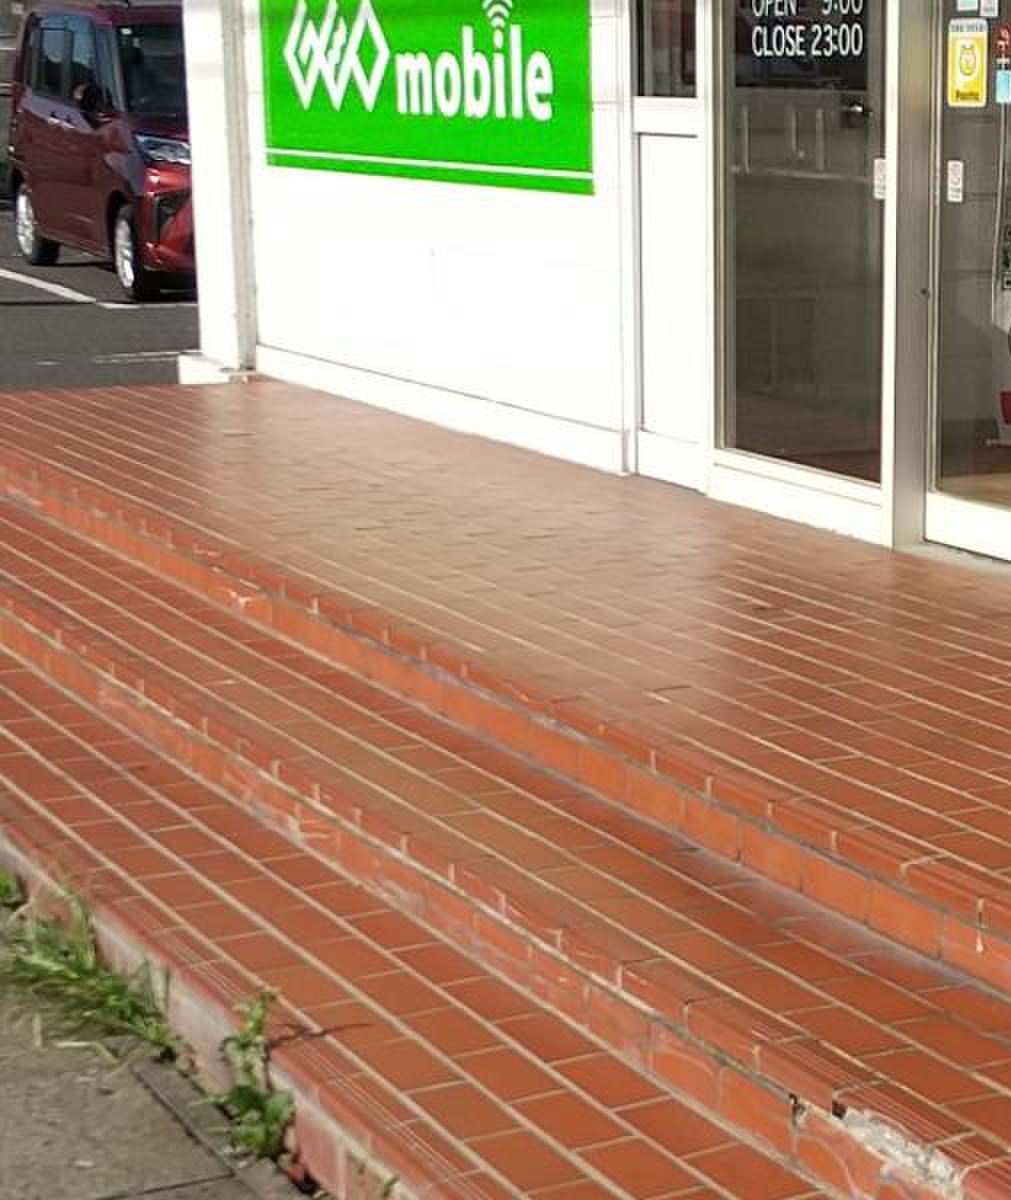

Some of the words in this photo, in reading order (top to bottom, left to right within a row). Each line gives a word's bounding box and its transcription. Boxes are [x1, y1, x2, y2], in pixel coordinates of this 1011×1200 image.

[395, 22, 554, 121] mobile
[751, 24, 806, 57] CLOSE
[811, 23, 864, 57] 23:00
